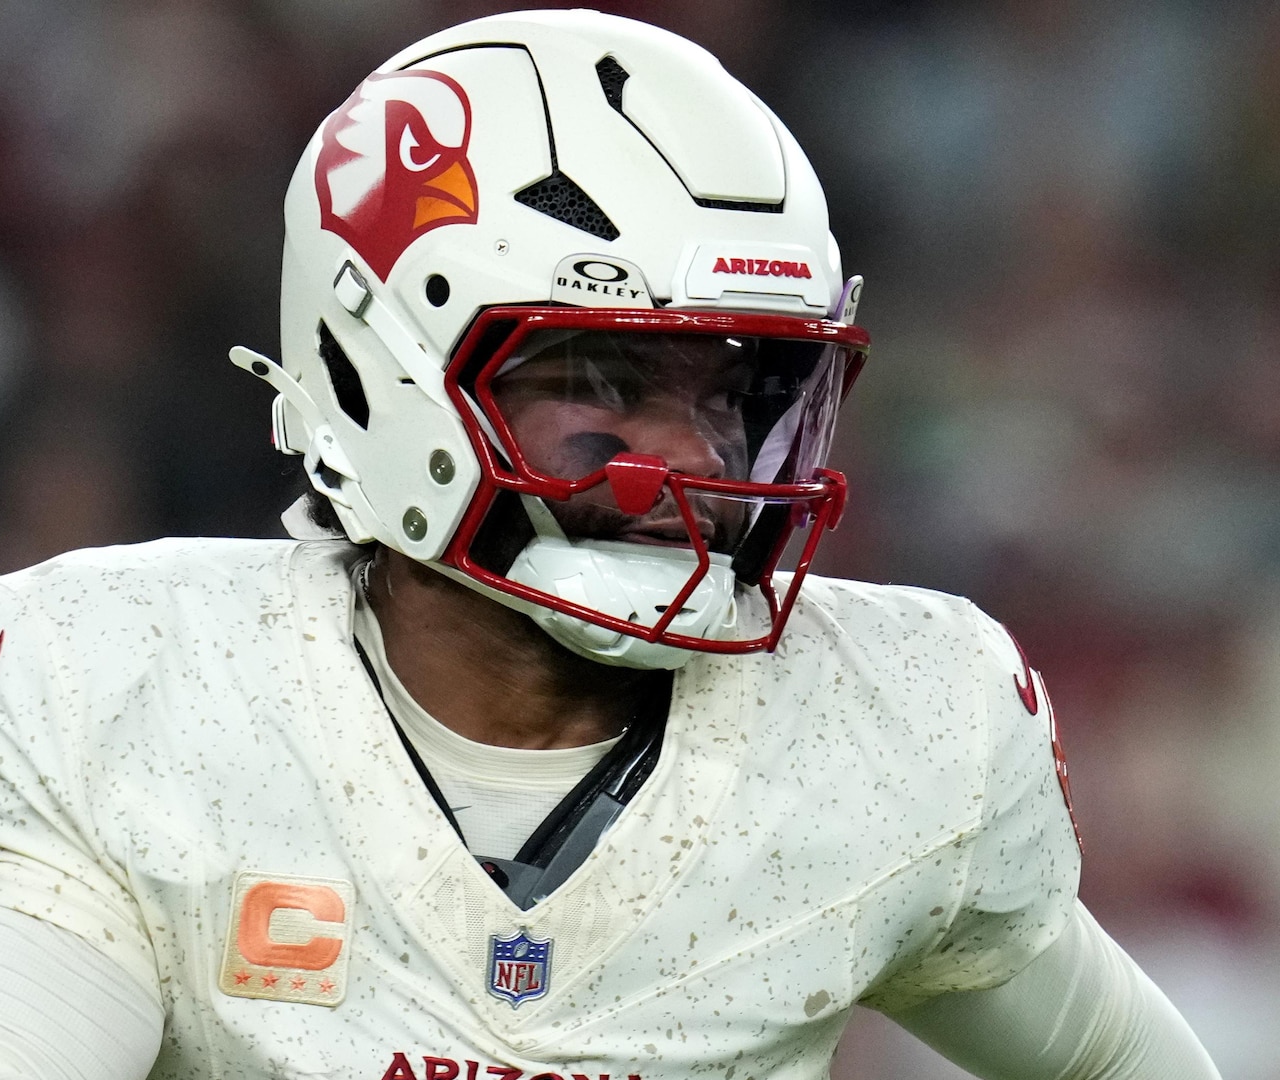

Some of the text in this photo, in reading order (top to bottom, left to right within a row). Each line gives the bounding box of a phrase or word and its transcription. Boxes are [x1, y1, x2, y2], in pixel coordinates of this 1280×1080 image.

[712, 257, 812, 279] ARIZONA
[557, 277, 640, 298] OAKLEY
[237, 881, 345, 971] C
[496, 962, 539, 993] NFL
